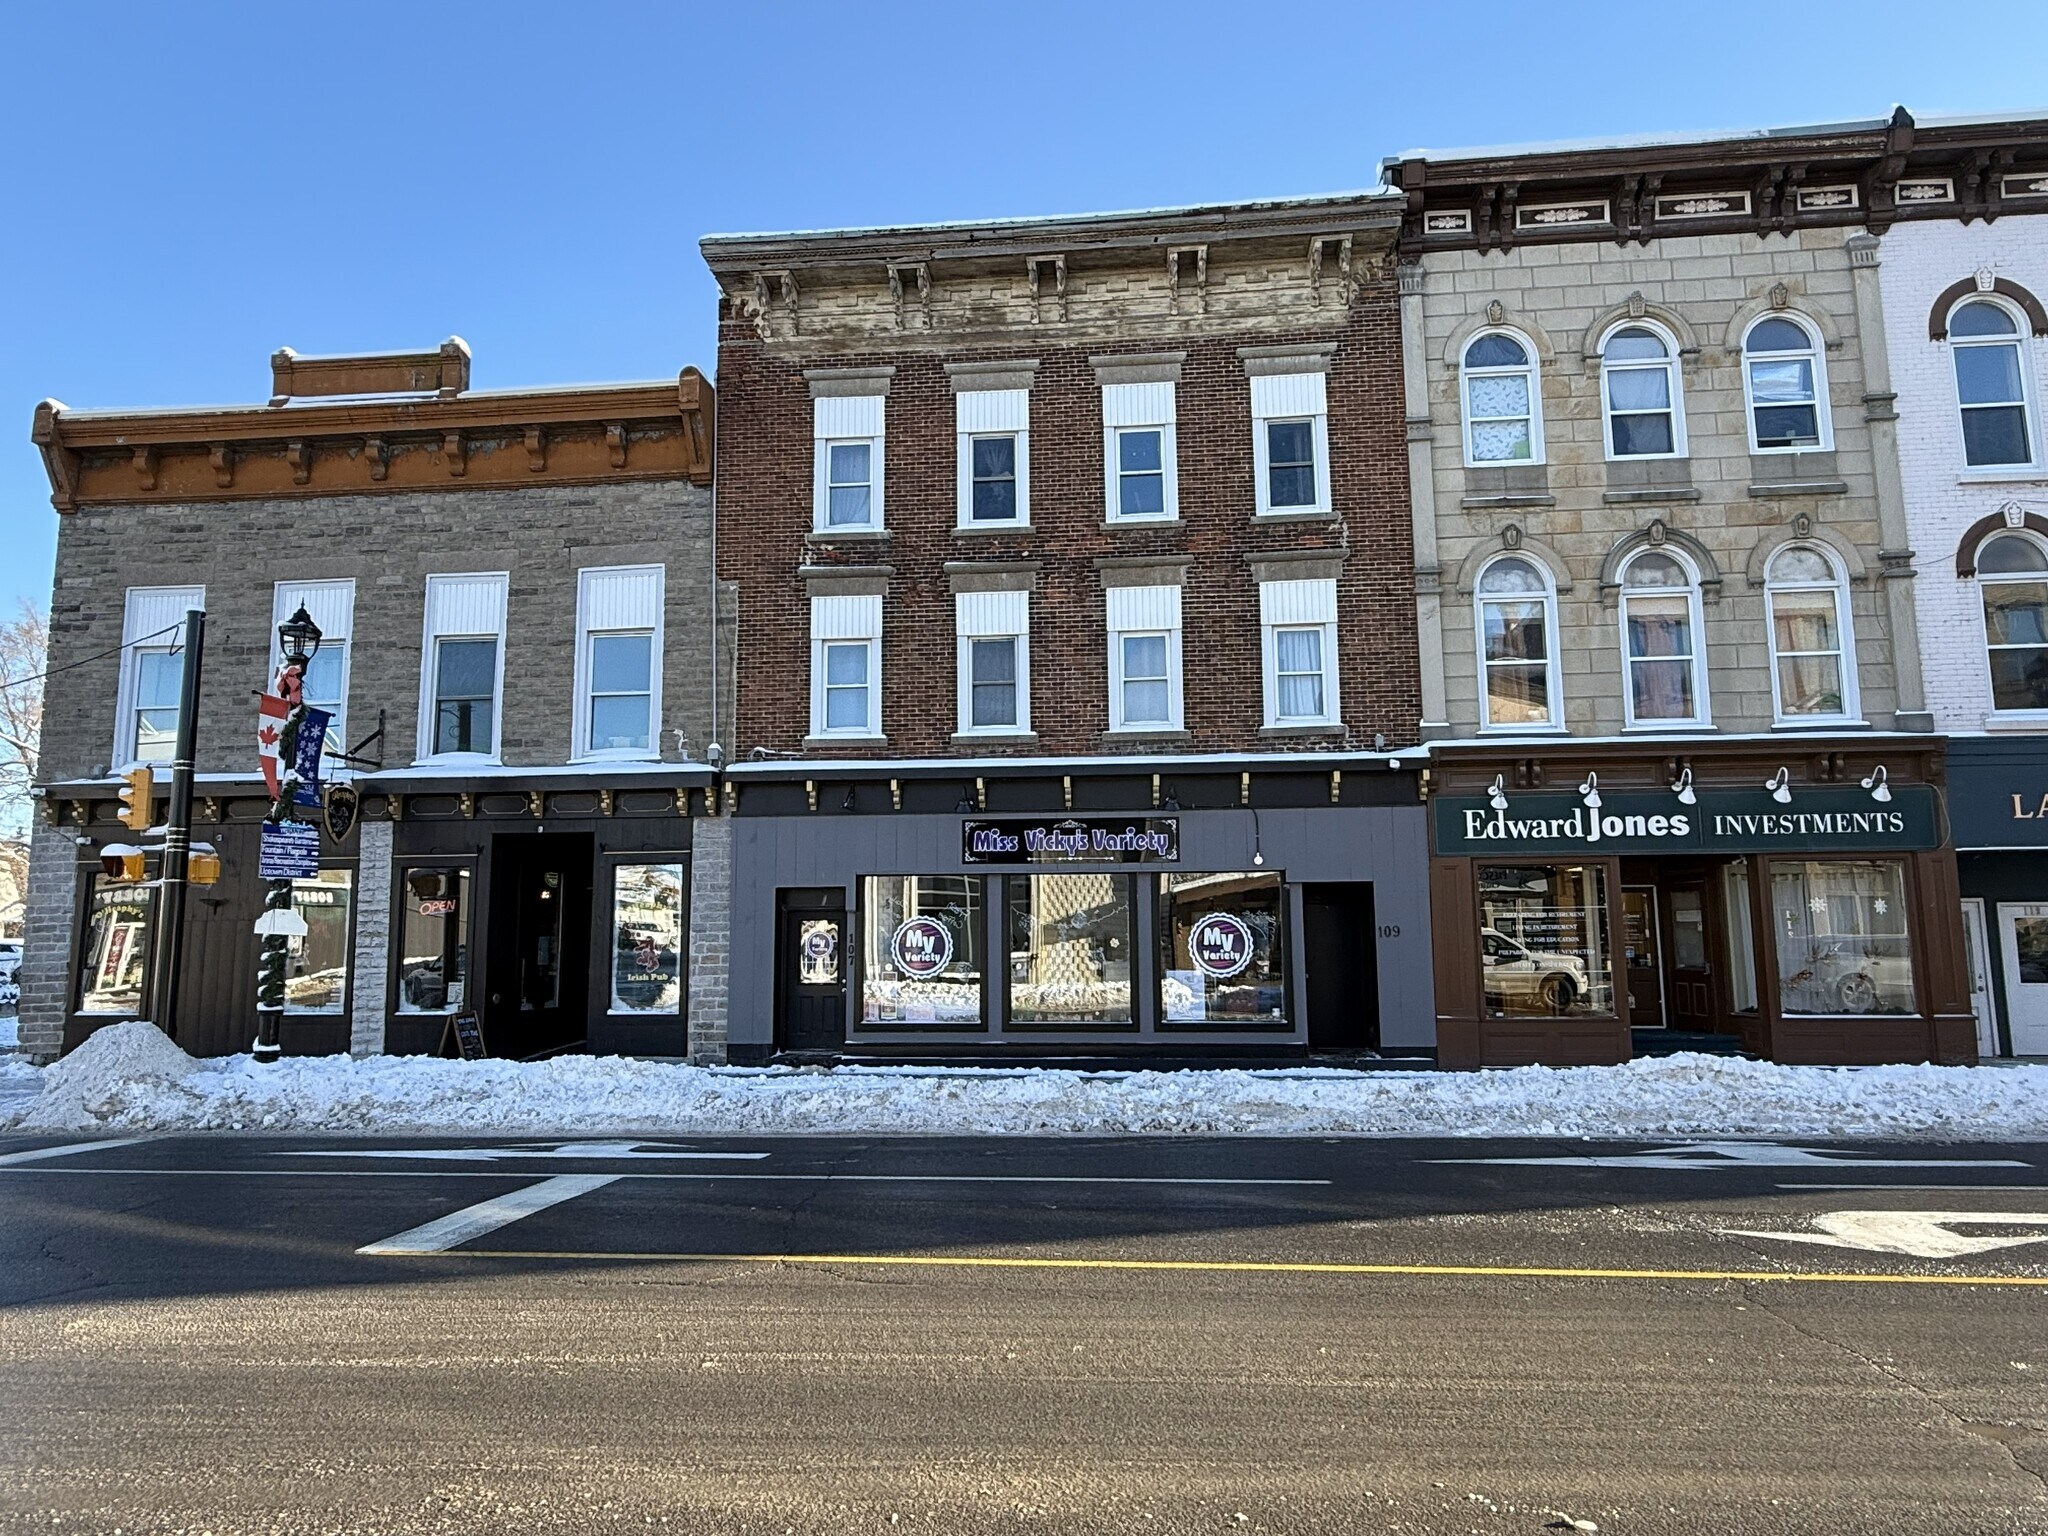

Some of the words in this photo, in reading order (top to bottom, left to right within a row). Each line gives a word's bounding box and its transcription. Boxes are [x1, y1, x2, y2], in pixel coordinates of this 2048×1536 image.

[1462, 807, 1585, 840] Edward
[1586, 807, 1691, 842] Jones
[1714, 812, 1905, 836] INVESTMENTS
[973, 828, 1019, 852] Miss
[1024, 827, 1089, 856] Vicky's
[1092, 826, 1169, 856] Variety
[260, 867, 283, 876] Uptown
[283, 867, 303, 877] District
[420, 899, 456, 915] OPEN
[1378, 925, 1400, 938] 109
[904, 951, 941, 963] Variety
[1203, 949, 1240, 962] Variety
[627, 973, 649, 981] Irish
[650, 973, 669, 981] Pub
